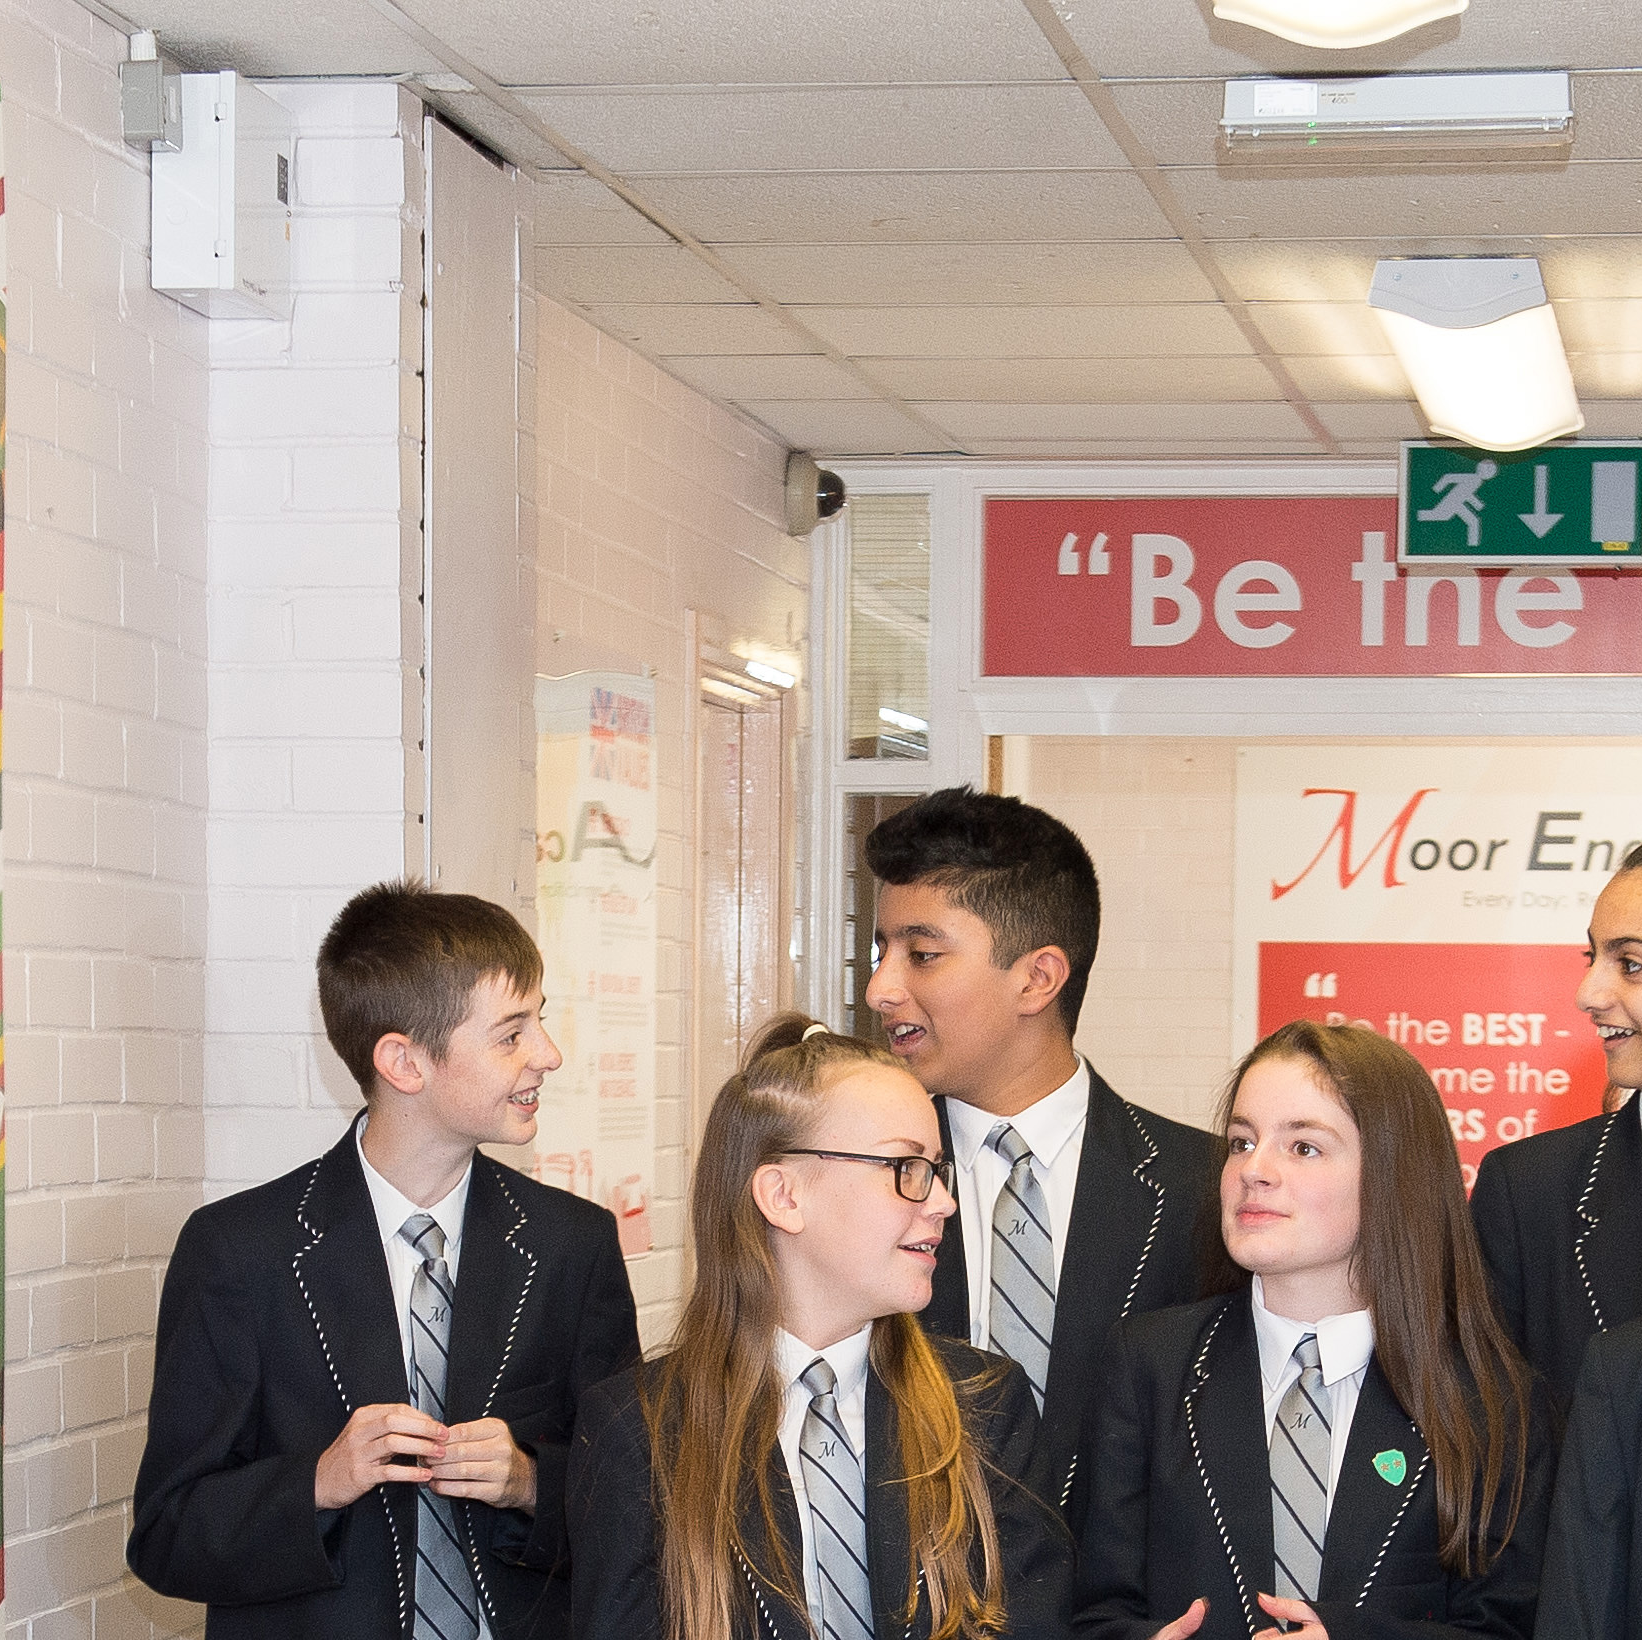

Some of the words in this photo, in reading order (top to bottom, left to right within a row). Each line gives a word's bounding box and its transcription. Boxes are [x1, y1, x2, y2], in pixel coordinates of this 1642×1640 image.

[1055, 532, 1303, 648] “Be
[1351, 531, 1584, 648] the
[1270, 788, 1508, 900] Moor
[1386, 1012, 1451, 1046] the
[1462, 1013, 1546, 1045] BEST
[1505, 1061, 1571, 1095] the
[1496, 1108, 1539, 1142] of
[1007, 1219, 1028, 1236] M
[428, 1307, 447, 1324] M
[1290, 1411, 1312, 1430] M
[818, 1439, 838, 1459] M
